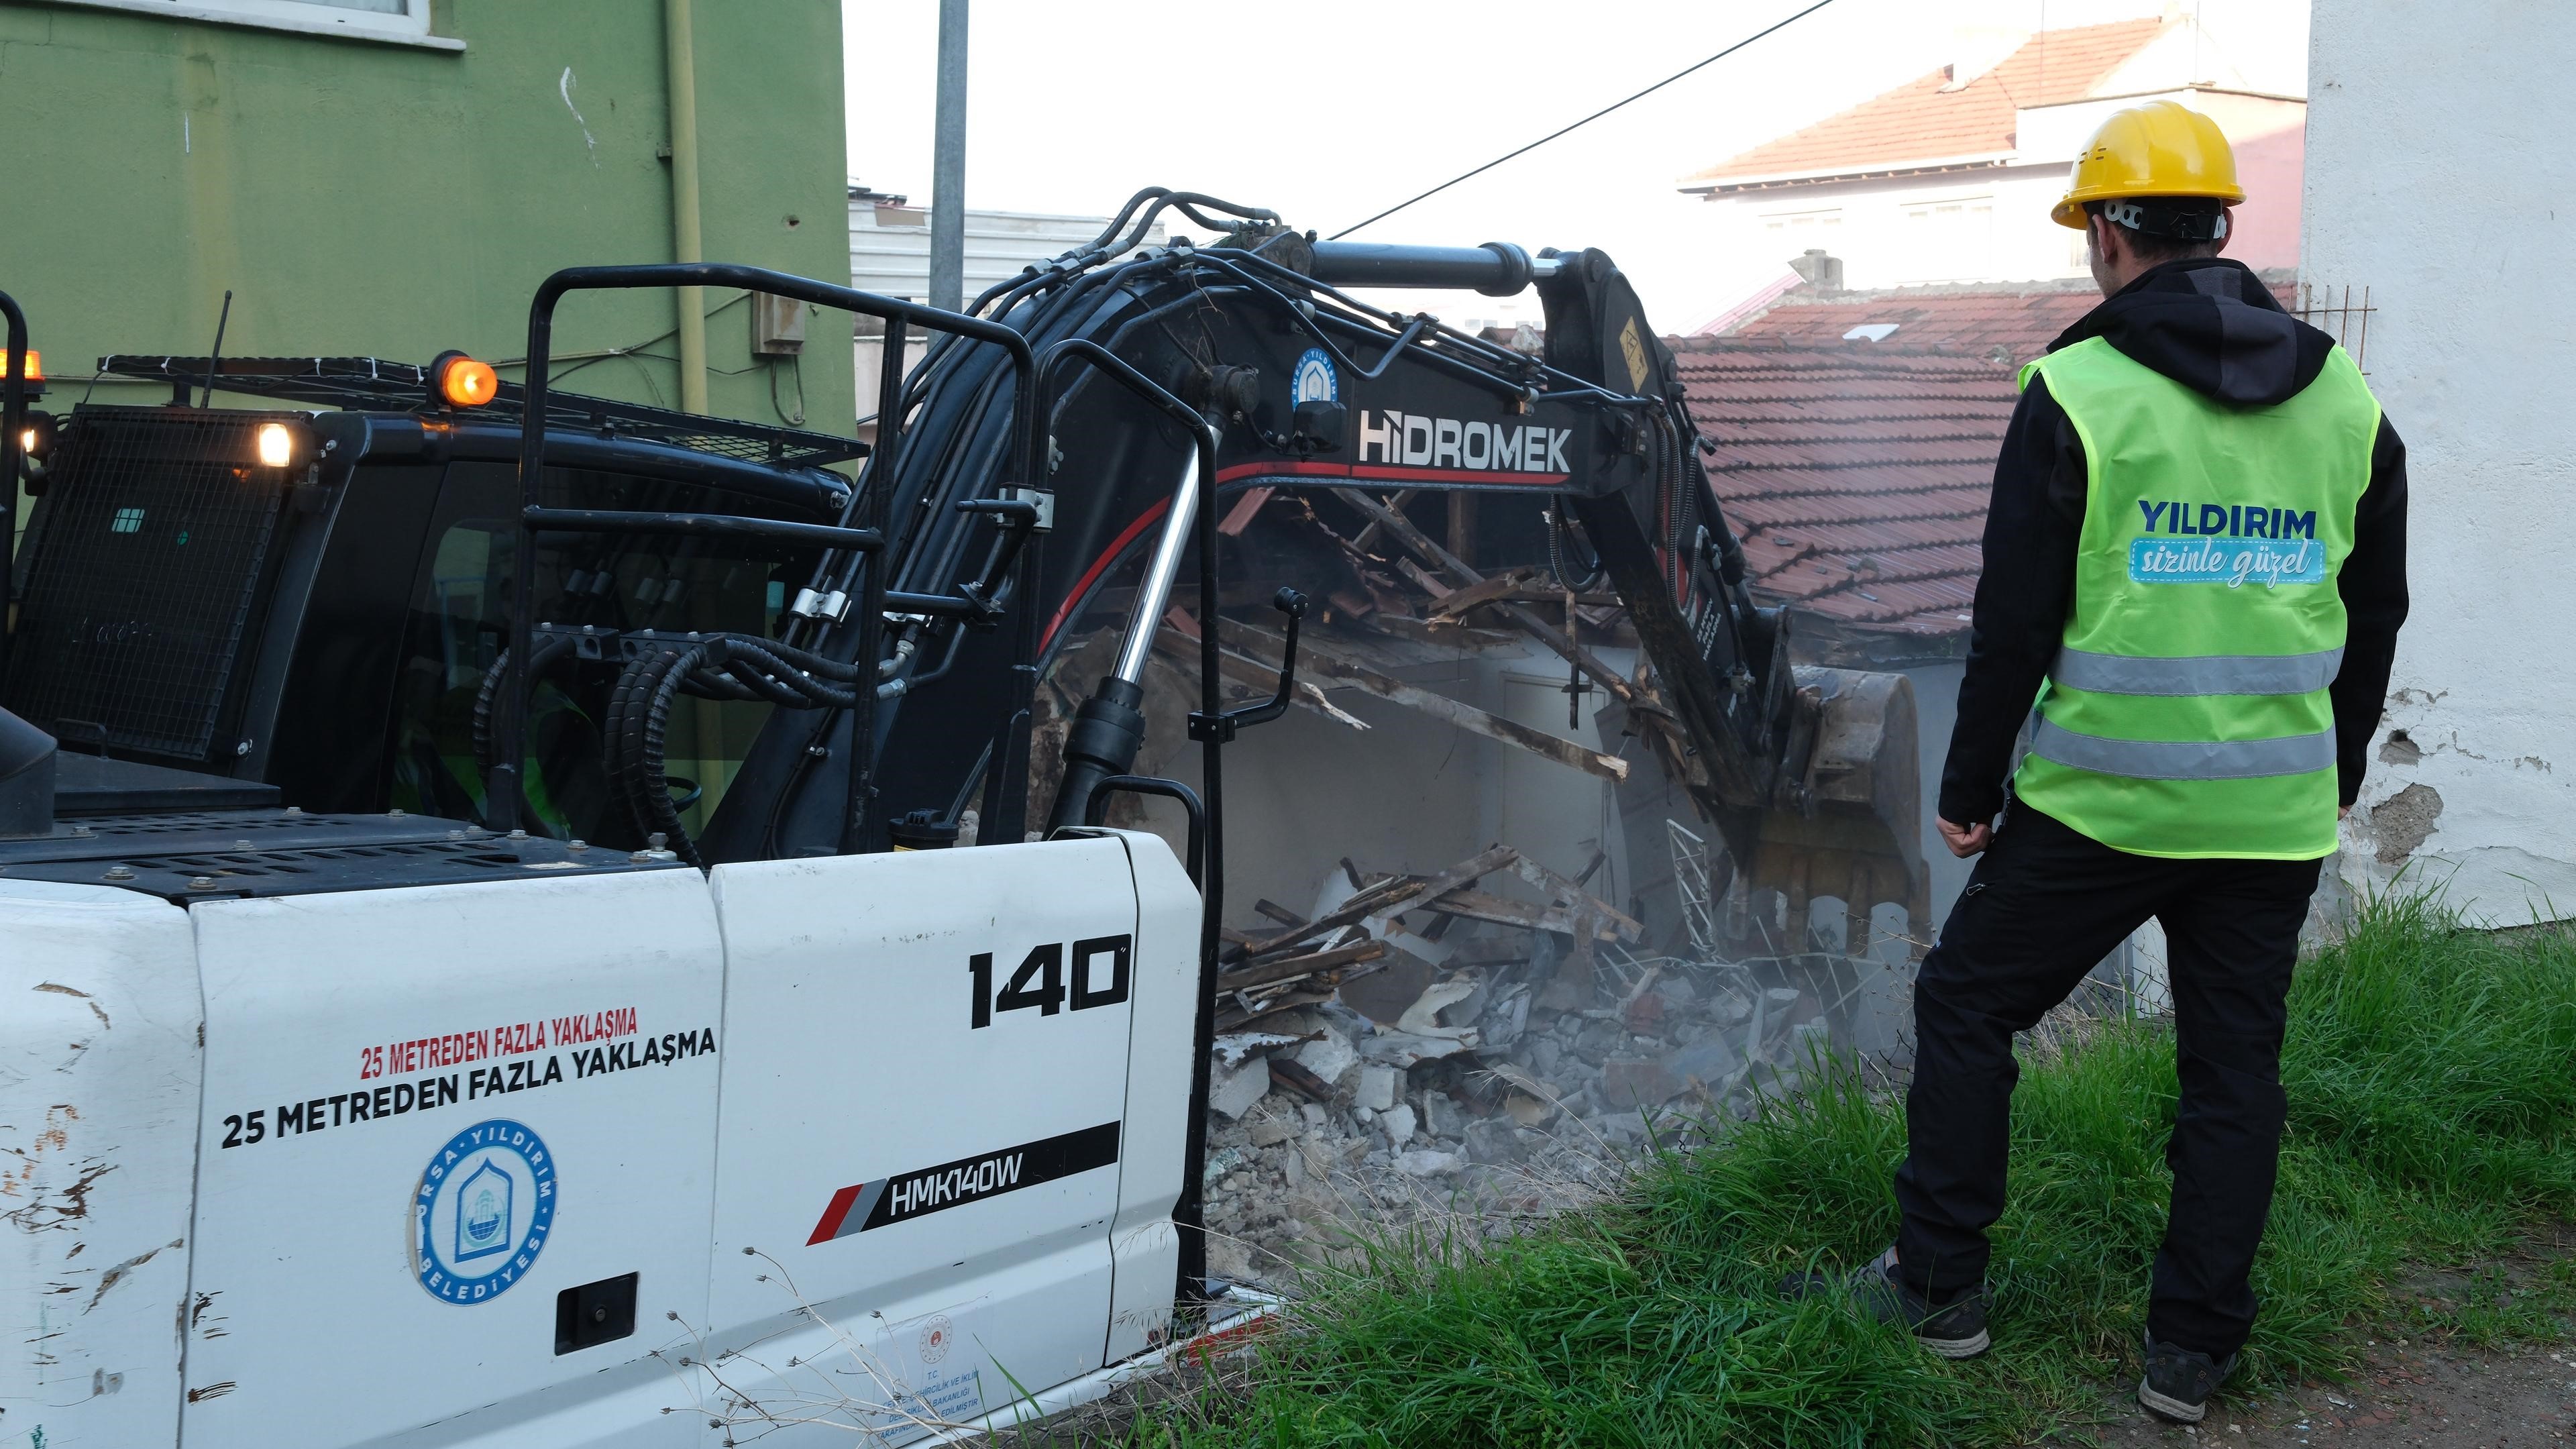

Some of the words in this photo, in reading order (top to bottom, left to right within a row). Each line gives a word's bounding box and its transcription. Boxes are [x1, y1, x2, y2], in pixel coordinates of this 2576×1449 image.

[1292, 356, 1307, 395] BURSA
[1311, 351, 1336, 394] YILDIRIM
[2138, 500, 2316, 539] YILDIRIM
[2141, 536, 2228, 574] sizinle
[2227, 538, 2312, 589] güzel
[969, 934, 1132, 1030] 140
[360, 1046, 383, 1080] 25
[390, 1029, 488, 1075] METREDEN
[494, 1020, 546, 1057] FAZLA
[551, 1007, 637, 1046] YAKLAŞMA
[221, 1110, 266, 1149] 25
[277, 1074, 459, 1138] METREDEN
[469, 1055, 564, 1100] FAZLA
[572, 1027, 716, 1079] YAKLAŞMA
[417, 1150, 458, 1220] URSA
[472, 1127, 551, 1198] YILDIRIM
[891, 1152, 1024, 1216] HMK140W
[928, 1371, 939, 1381] T.C.
[932, 1387, 970, 1407] BAKANLIĞI
[951, 1377, 960, 1387] VE
[941, 1398, 978, 1417] EDİLMİŞTİR
